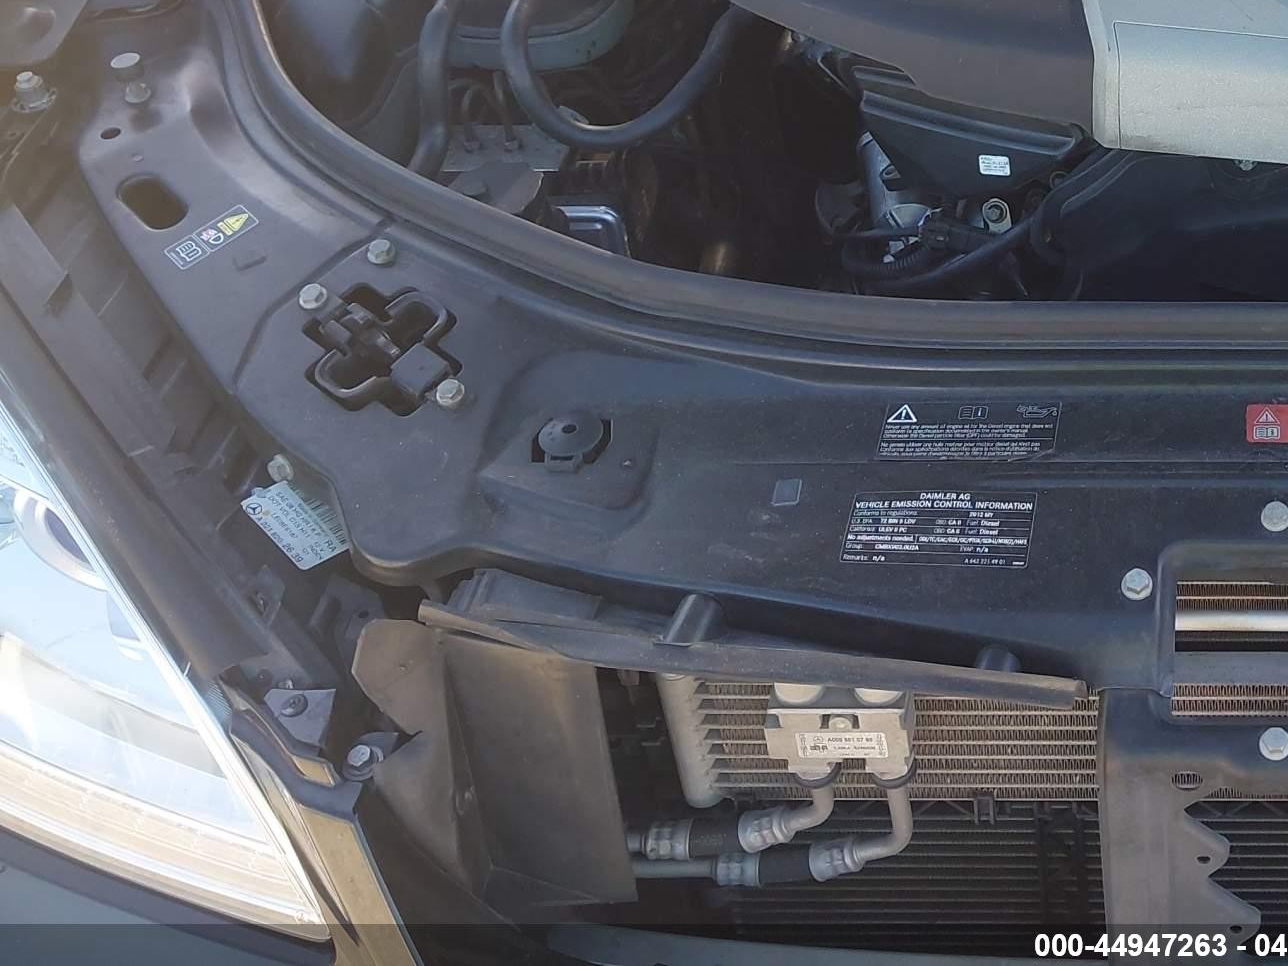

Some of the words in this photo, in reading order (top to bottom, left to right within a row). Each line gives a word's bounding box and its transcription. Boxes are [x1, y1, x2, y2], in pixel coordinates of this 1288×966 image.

[891, 500, 932, 508] EMISSION
[975, 502, 1033, 510] INFORMATION
[324, 540, 336, 552] RA
[282, 542, 295, 554] 26
[292, 552, 304, 563] 39
[872, 554, 885, 562] n/a
